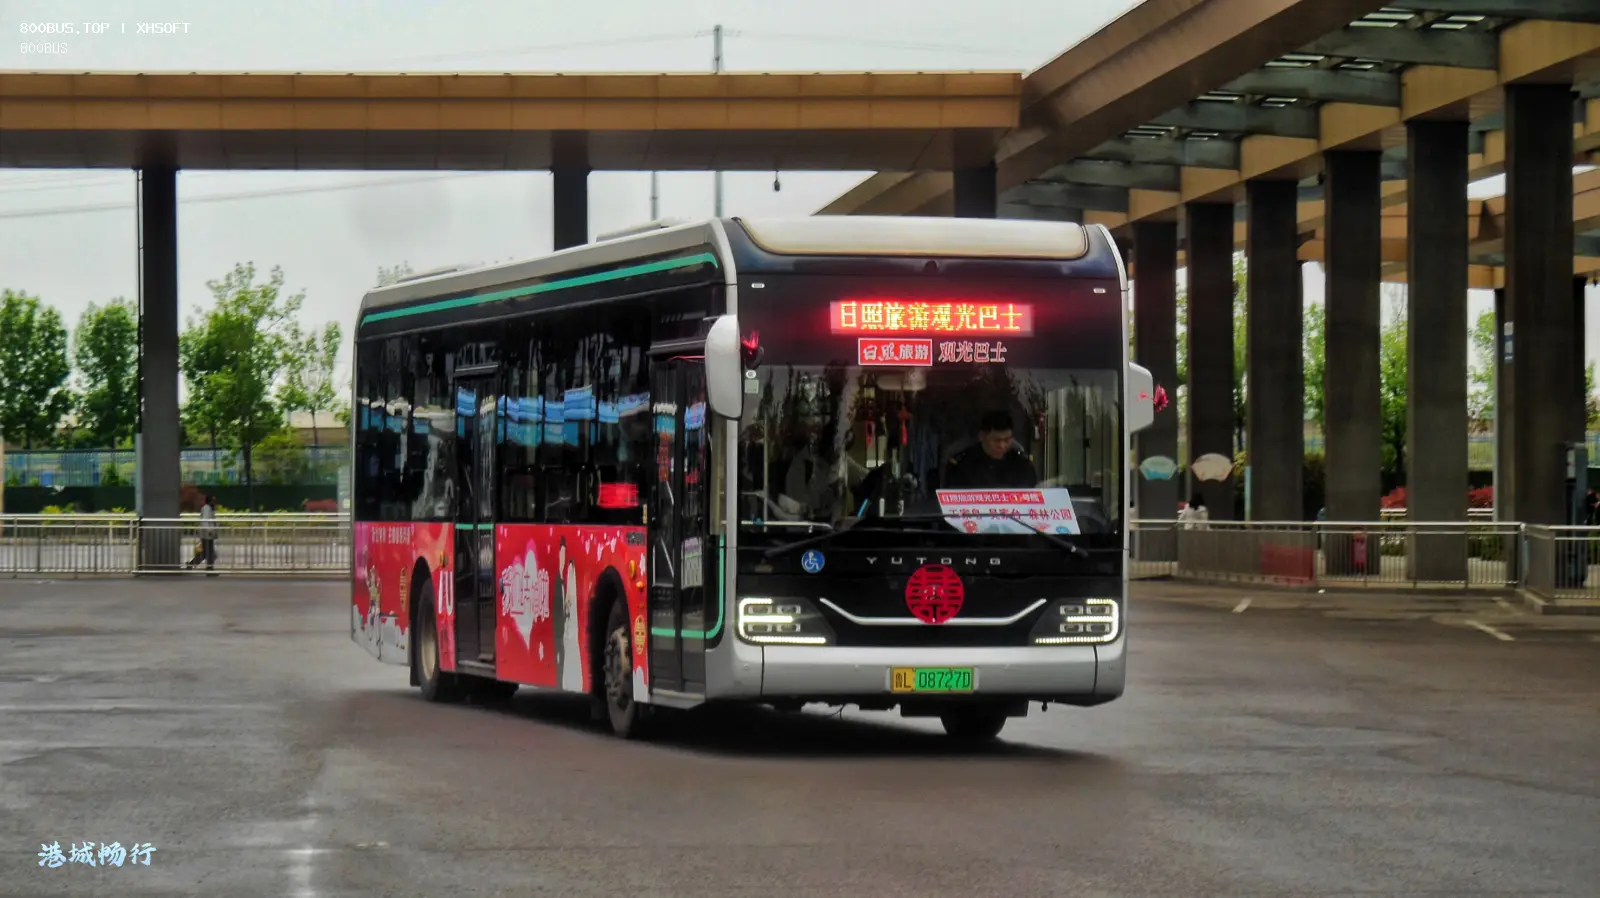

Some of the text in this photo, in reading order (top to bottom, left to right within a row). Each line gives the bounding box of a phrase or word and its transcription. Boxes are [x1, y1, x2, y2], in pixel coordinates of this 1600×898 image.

[839, 301, 1023, 332] 日照旅游观光巴士
[938, 340, 1008, 363] 观光巴士
[866, 556, 1001, 566] YUTONG
[918, 671, 971, 688] 08727D
